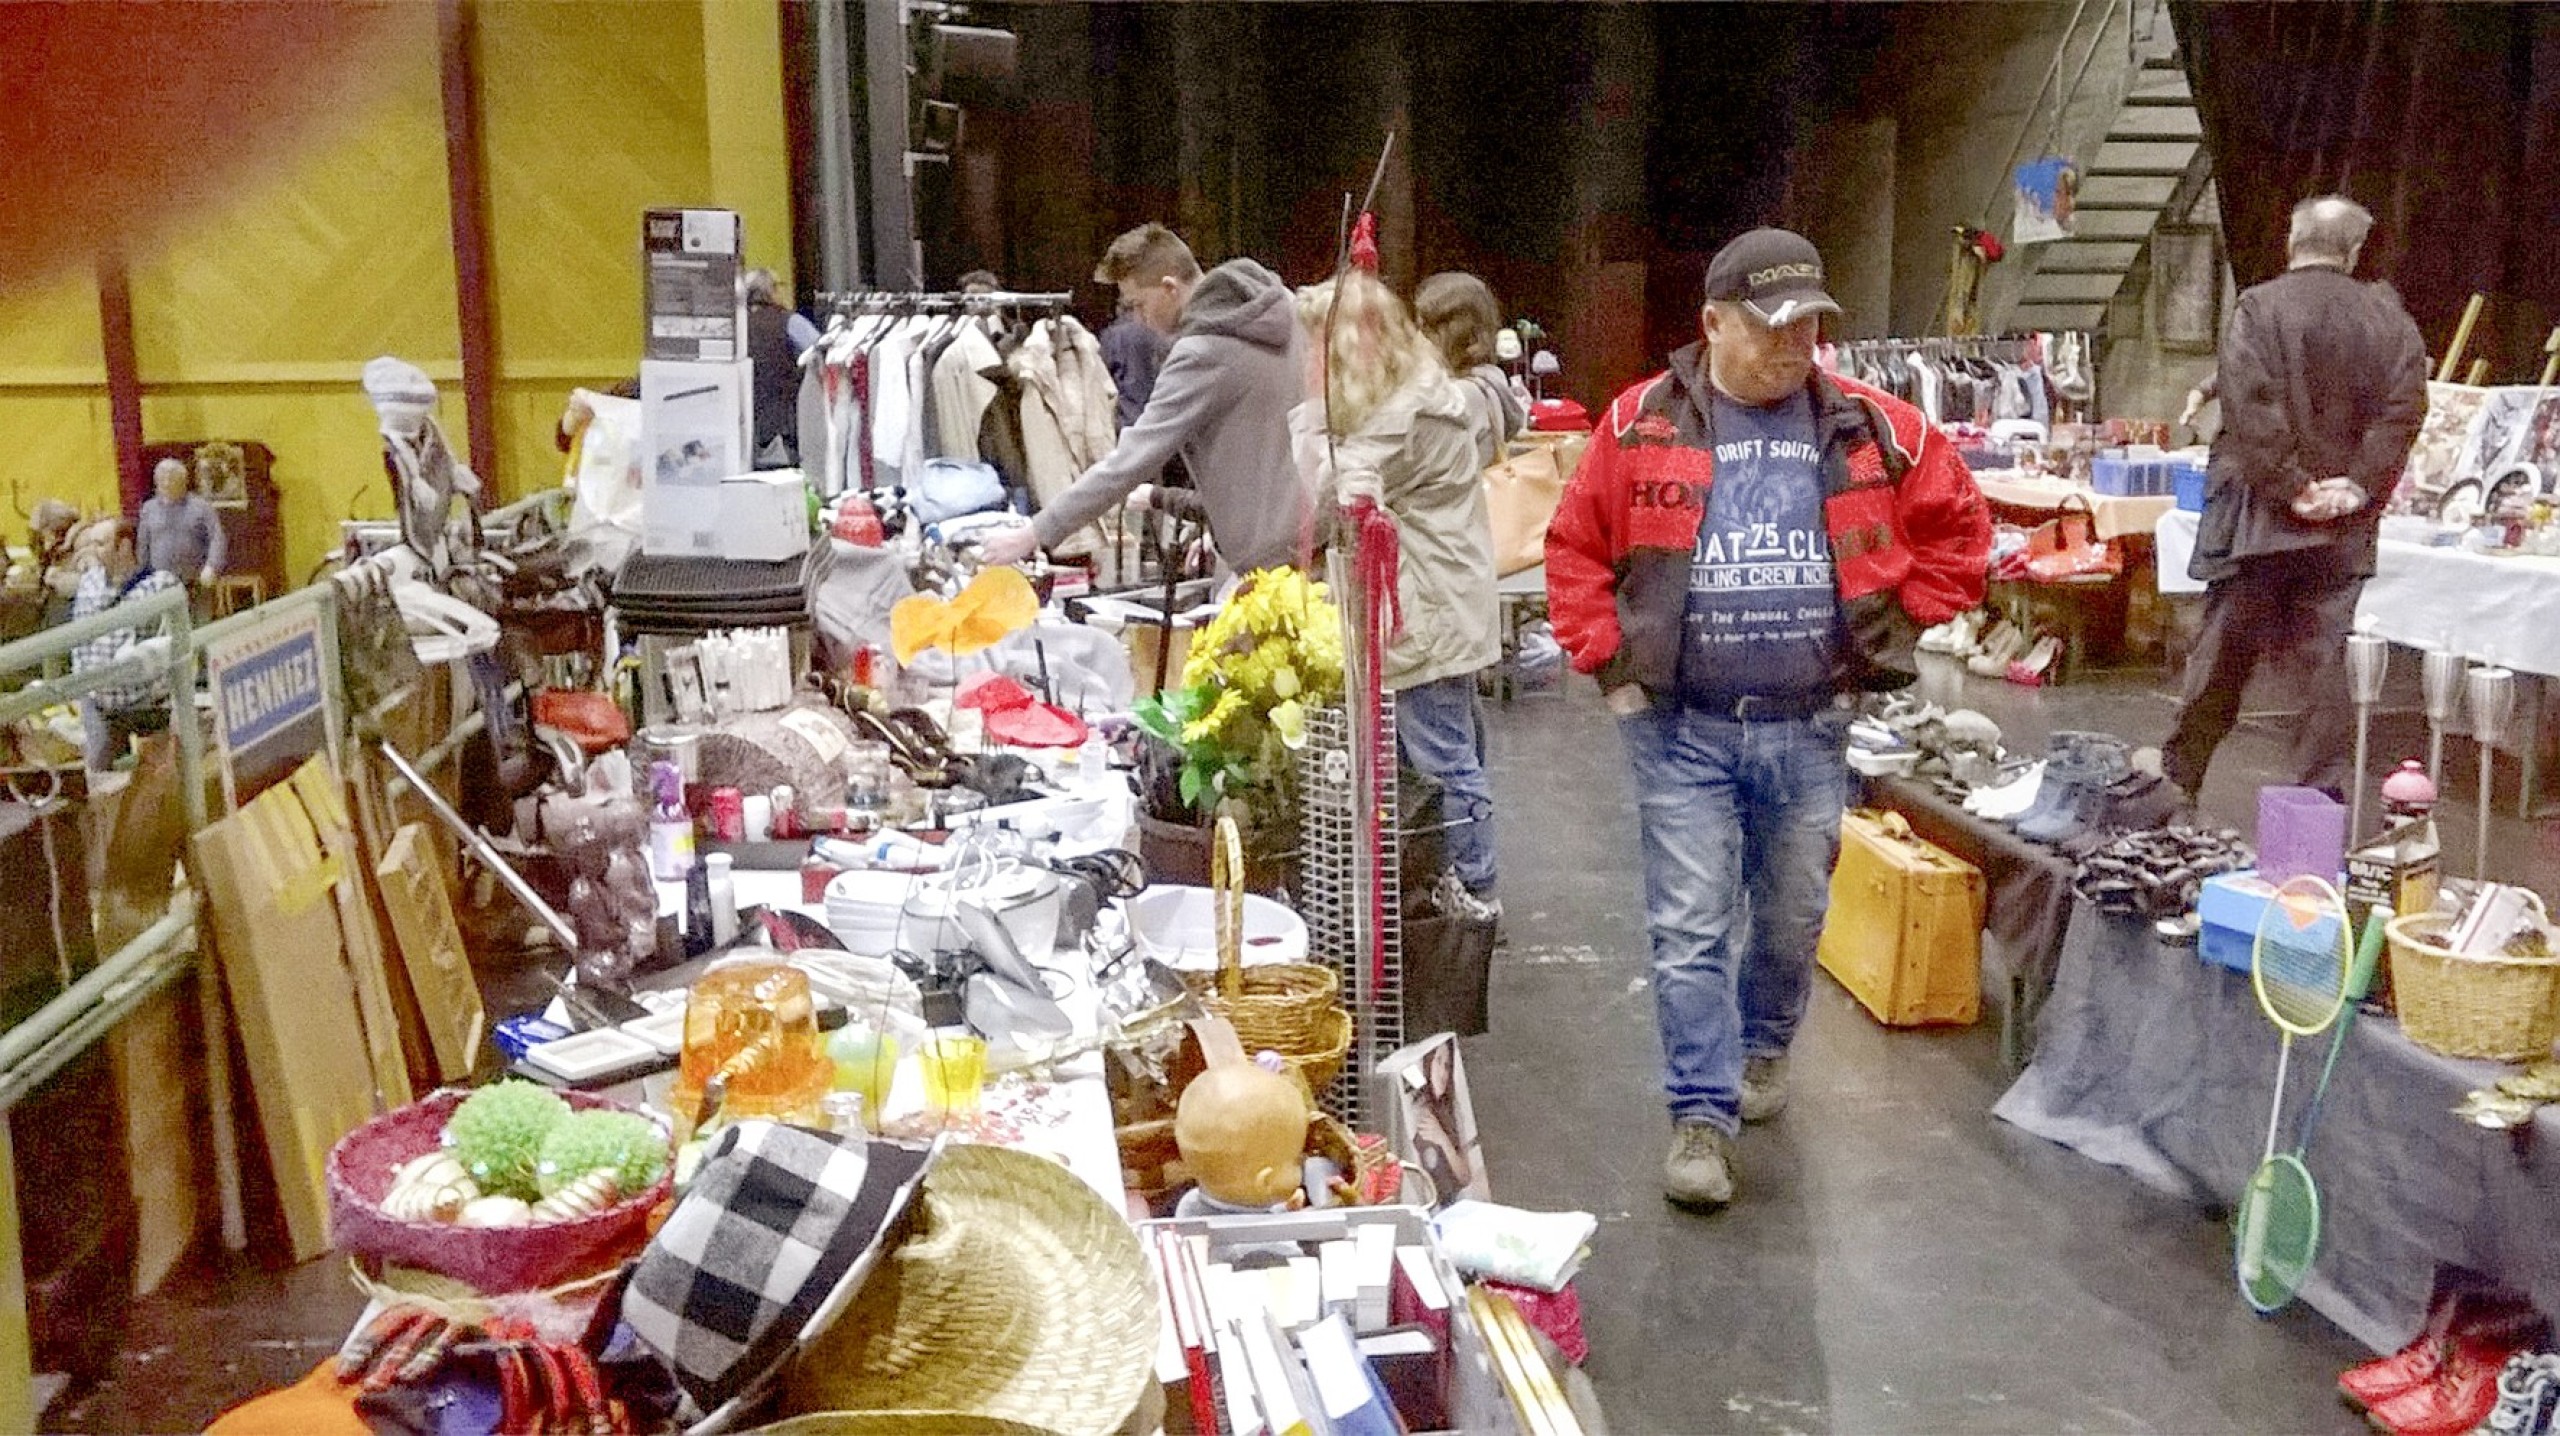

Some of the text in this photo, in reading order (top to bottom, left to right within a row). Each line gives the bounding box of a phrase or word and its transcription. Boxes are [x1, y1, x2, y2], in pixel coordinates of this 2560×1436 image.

[1715, 439, 1762, 464] DRIFT
[1769, 439, 1820, 465] SOUTH
[1750, 522, 1779, 549] 75
[1748, 566, 1797, 586] CREW
